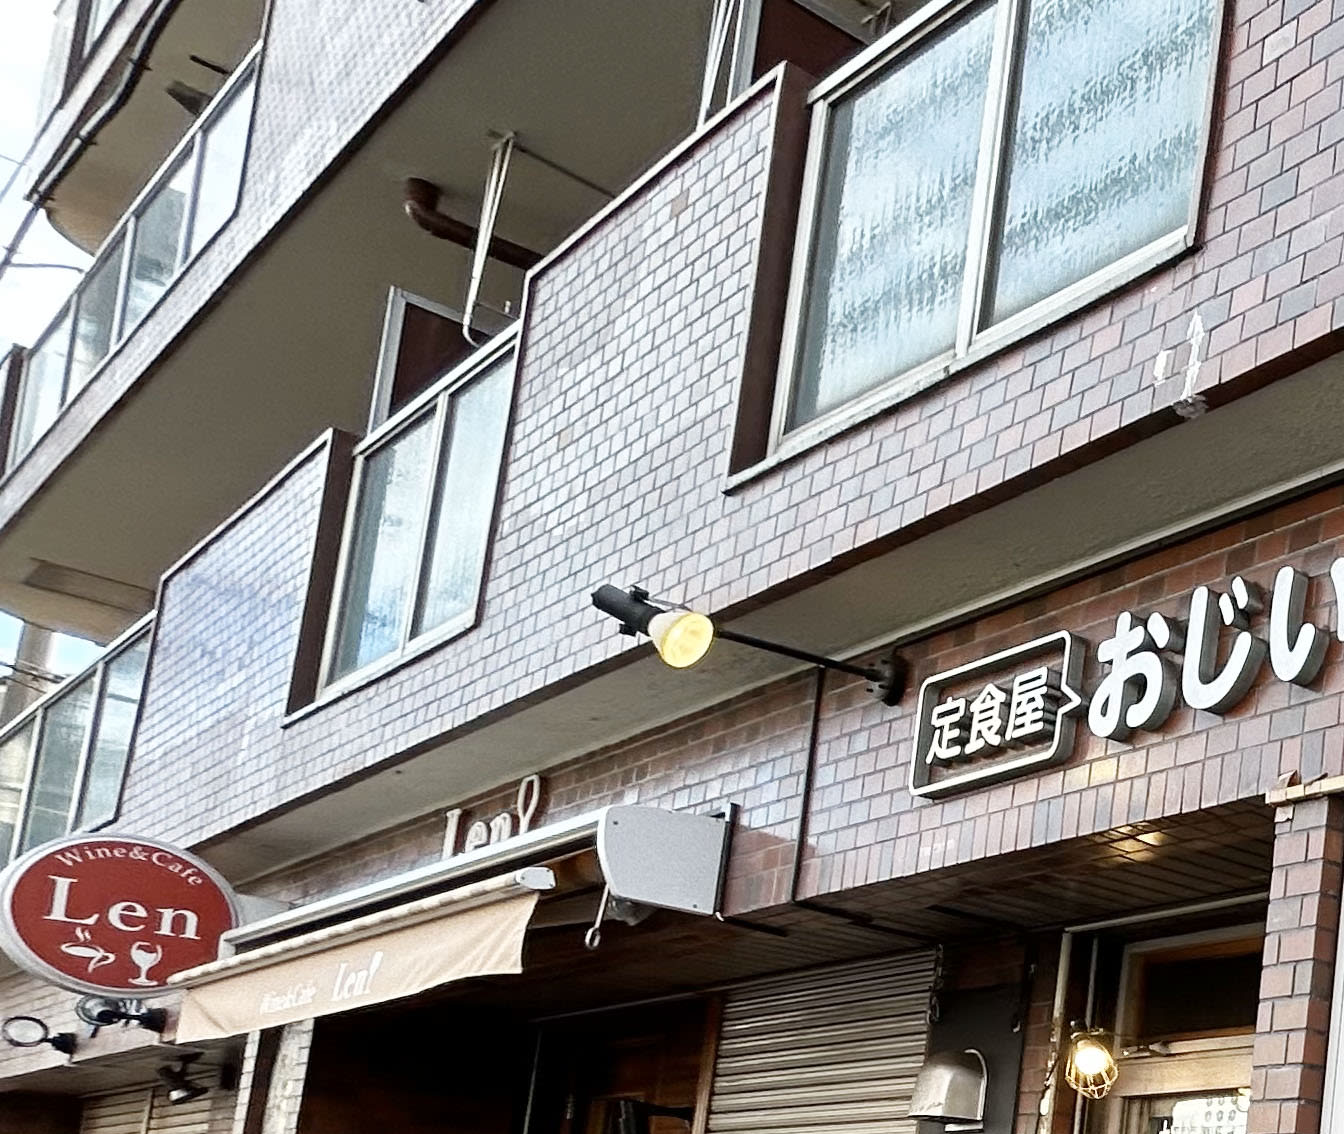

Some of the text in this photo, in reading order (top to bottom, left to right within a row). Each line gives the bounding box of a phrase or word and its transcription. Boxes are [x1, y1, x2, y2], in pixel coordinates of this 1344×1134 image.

[926, 666, 1049, 765] 定食屋
[55, 845, 203, 886] Wine&Cafe
[43, 874, 201, 940] Len
